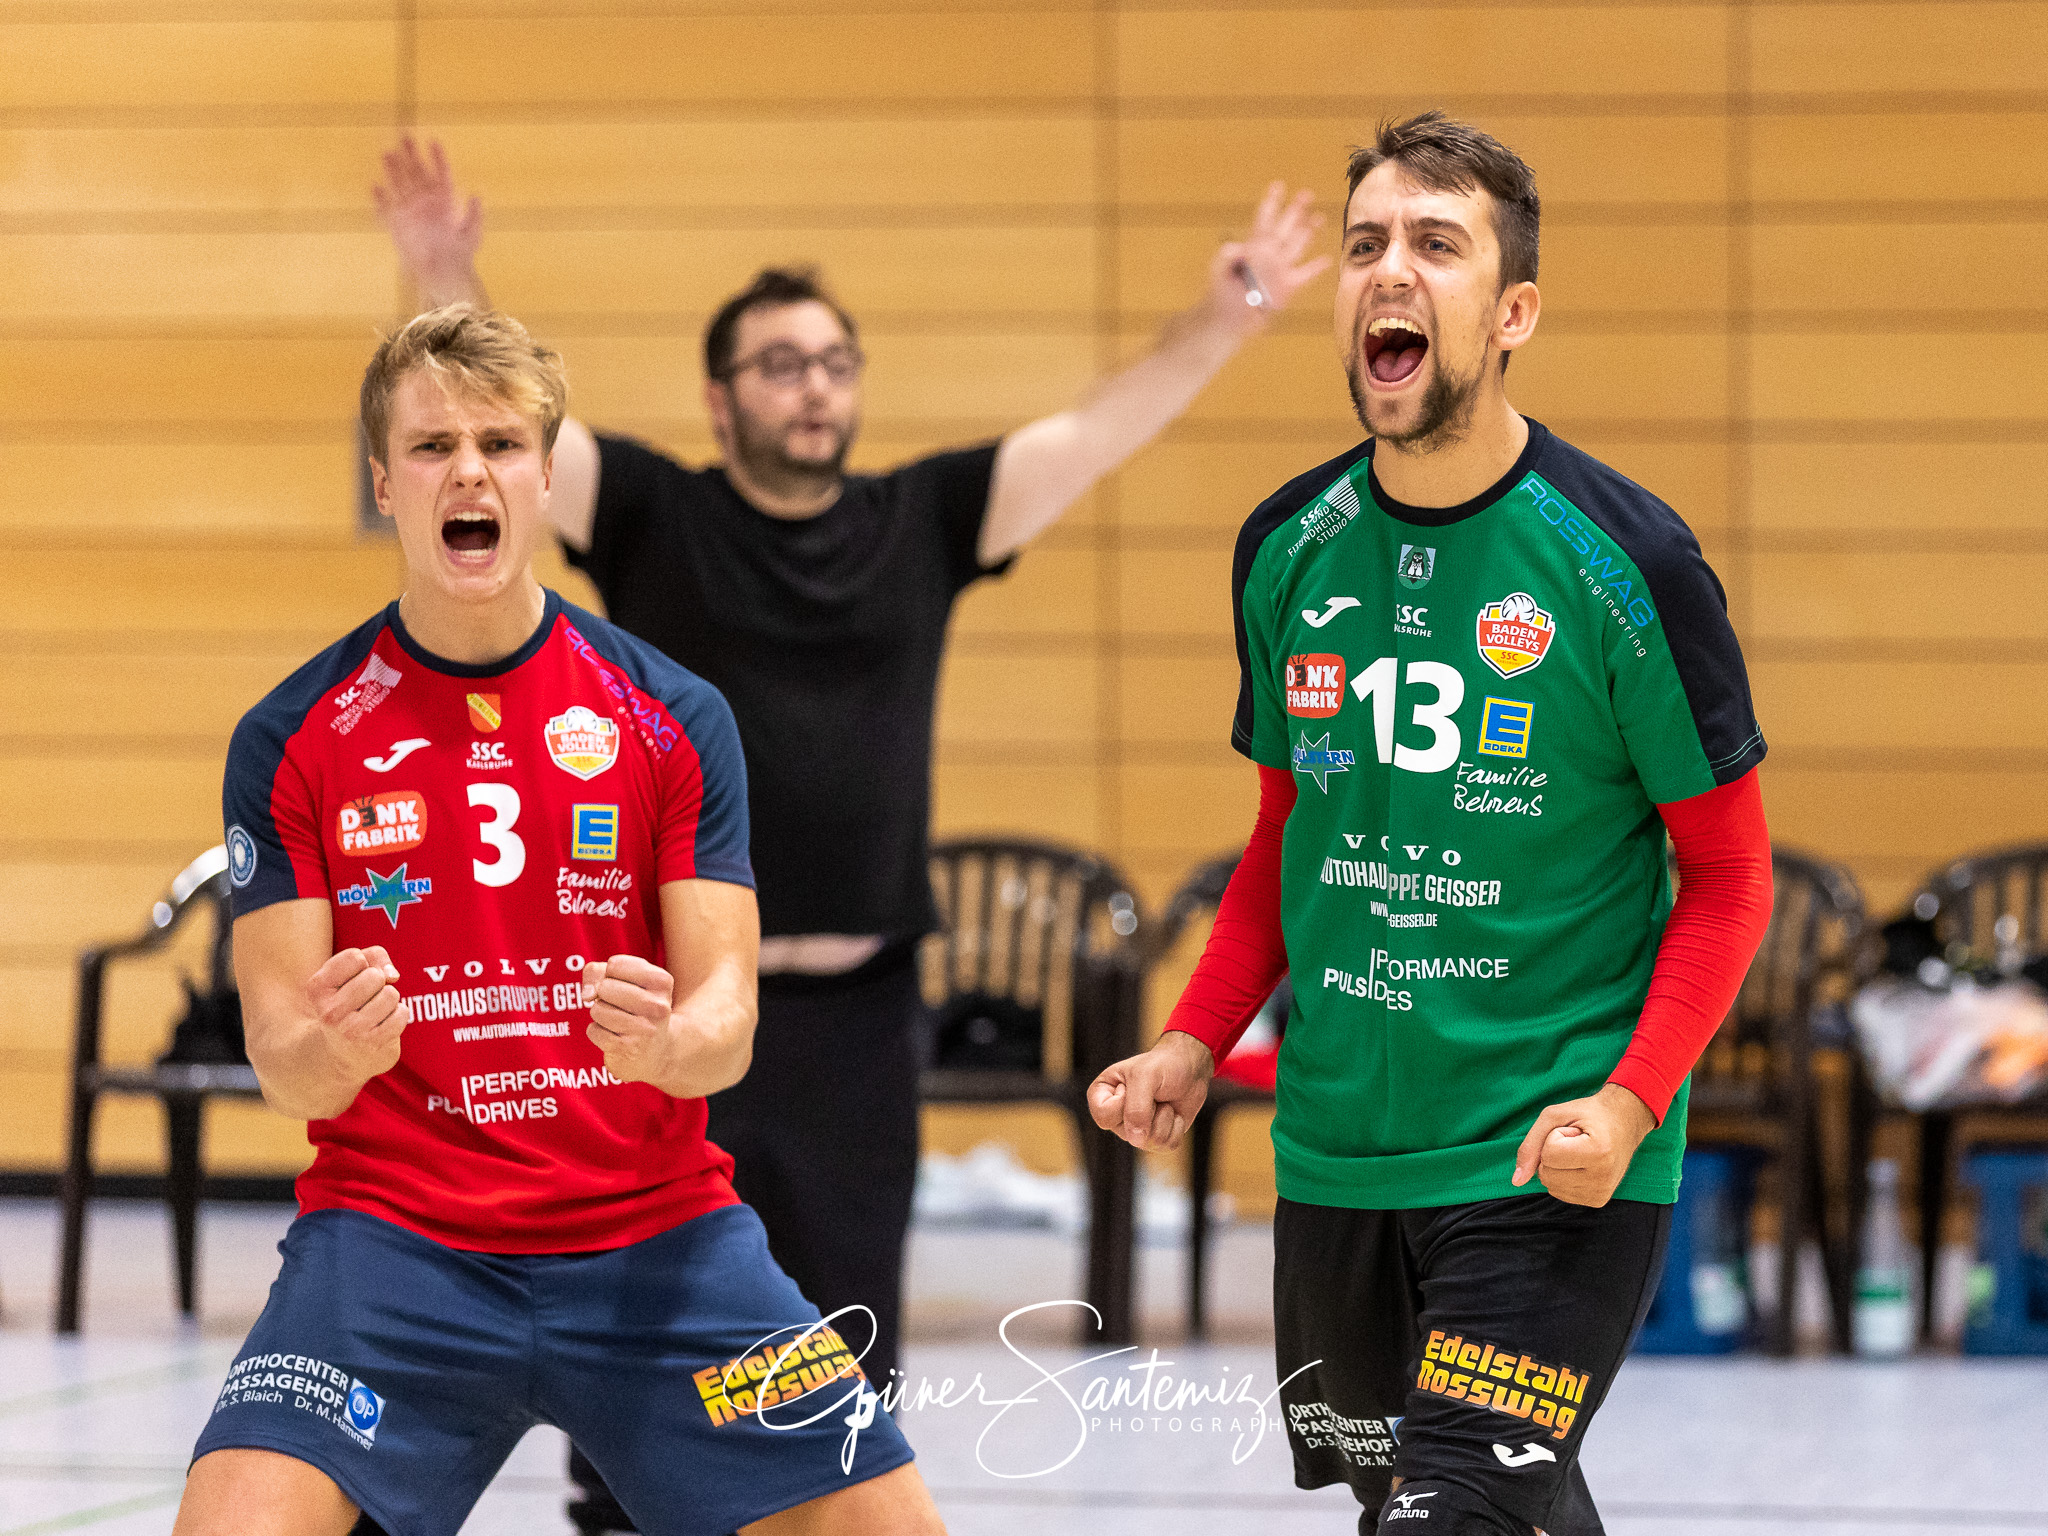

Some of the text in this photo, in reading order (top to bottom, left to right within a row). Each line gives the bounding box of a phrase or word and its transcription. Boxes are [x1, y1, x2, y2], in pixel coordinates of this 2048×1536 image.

[1316, 518, 1347, 544] STUDIO
[1519, 477, 1654, 627] ROSSWAG
[1579, 567, 1647, 657] engineering
[1485, 633, 1541, 652] VOLLEYS
[1491, 623, 1539, 640] BADEN
[1500, 651, 1519, 662] SSC
[334, 685, 362, 710] SSC
[1287, 690, 1339, 709] FABRIK
[1349, 657, 1465, 773] 13
[470, 741, 506, 760] SSC
[556, 741, 611, 754] VOLLEYS
[560, 732, 606, 744] BADEN
[1483, 742, 1524, 754] EDEKA
[1456, 761, 1548, 788] Familie
[342, 823, 421, 851] FABRIK
[466, 783, 526, 887] 3
[556, 867, 633, 891] Familie
[1424, 874, 1502, 907] GEISSER
[423, 954, 586, 983] VOLVO
[401, 985, 550, 1025] UTOHAUSGRUPPE
[473, 1096, 558, 1125] DRIVES
[228, 1352, 350, 1392] ORTHOCENTER
[1424, 1329, 1591, 1404] Edelstahl
[220, 1372, 345, 1409] PASSAGEHOF
[1417, 1359, 1578, 1440] Rosswag
[242, 1389, 284, 1405] Blaich
[293, 1395, 314, 1413] Dr.
[316, 1403, 332, 1421] M.
[332, 1413, 374, 1451] Hammer
[352, 1393, 376, 1420] OP
[1305, 1437, 1327, 1449] Dr.
[1355, 1454, 1393, 1466] Dr. M.
